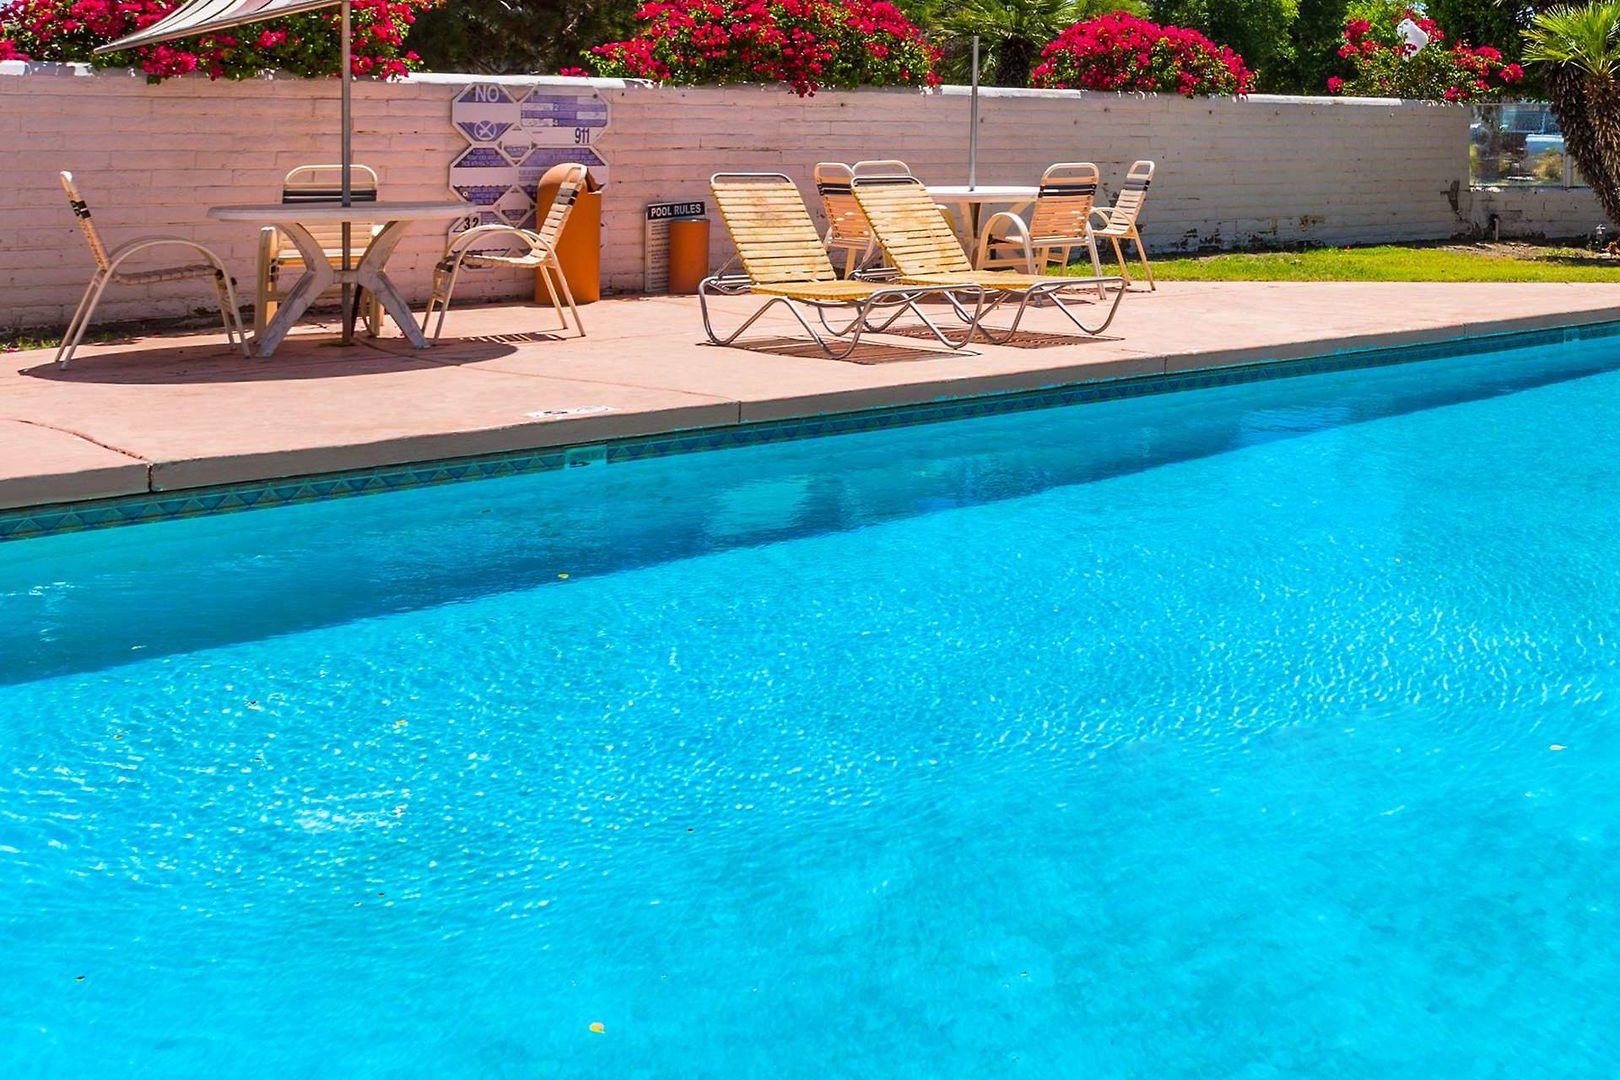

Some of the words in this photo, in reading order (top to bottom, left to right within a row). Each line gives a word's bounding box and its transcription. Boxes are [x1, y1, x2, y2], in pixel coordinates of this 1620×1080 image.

[475, 86, 500, 102] NO
[574, 127, 590, 144] 911
[651, 206, 672, 218] POOL
[674, 204, 702, 216] RULES
